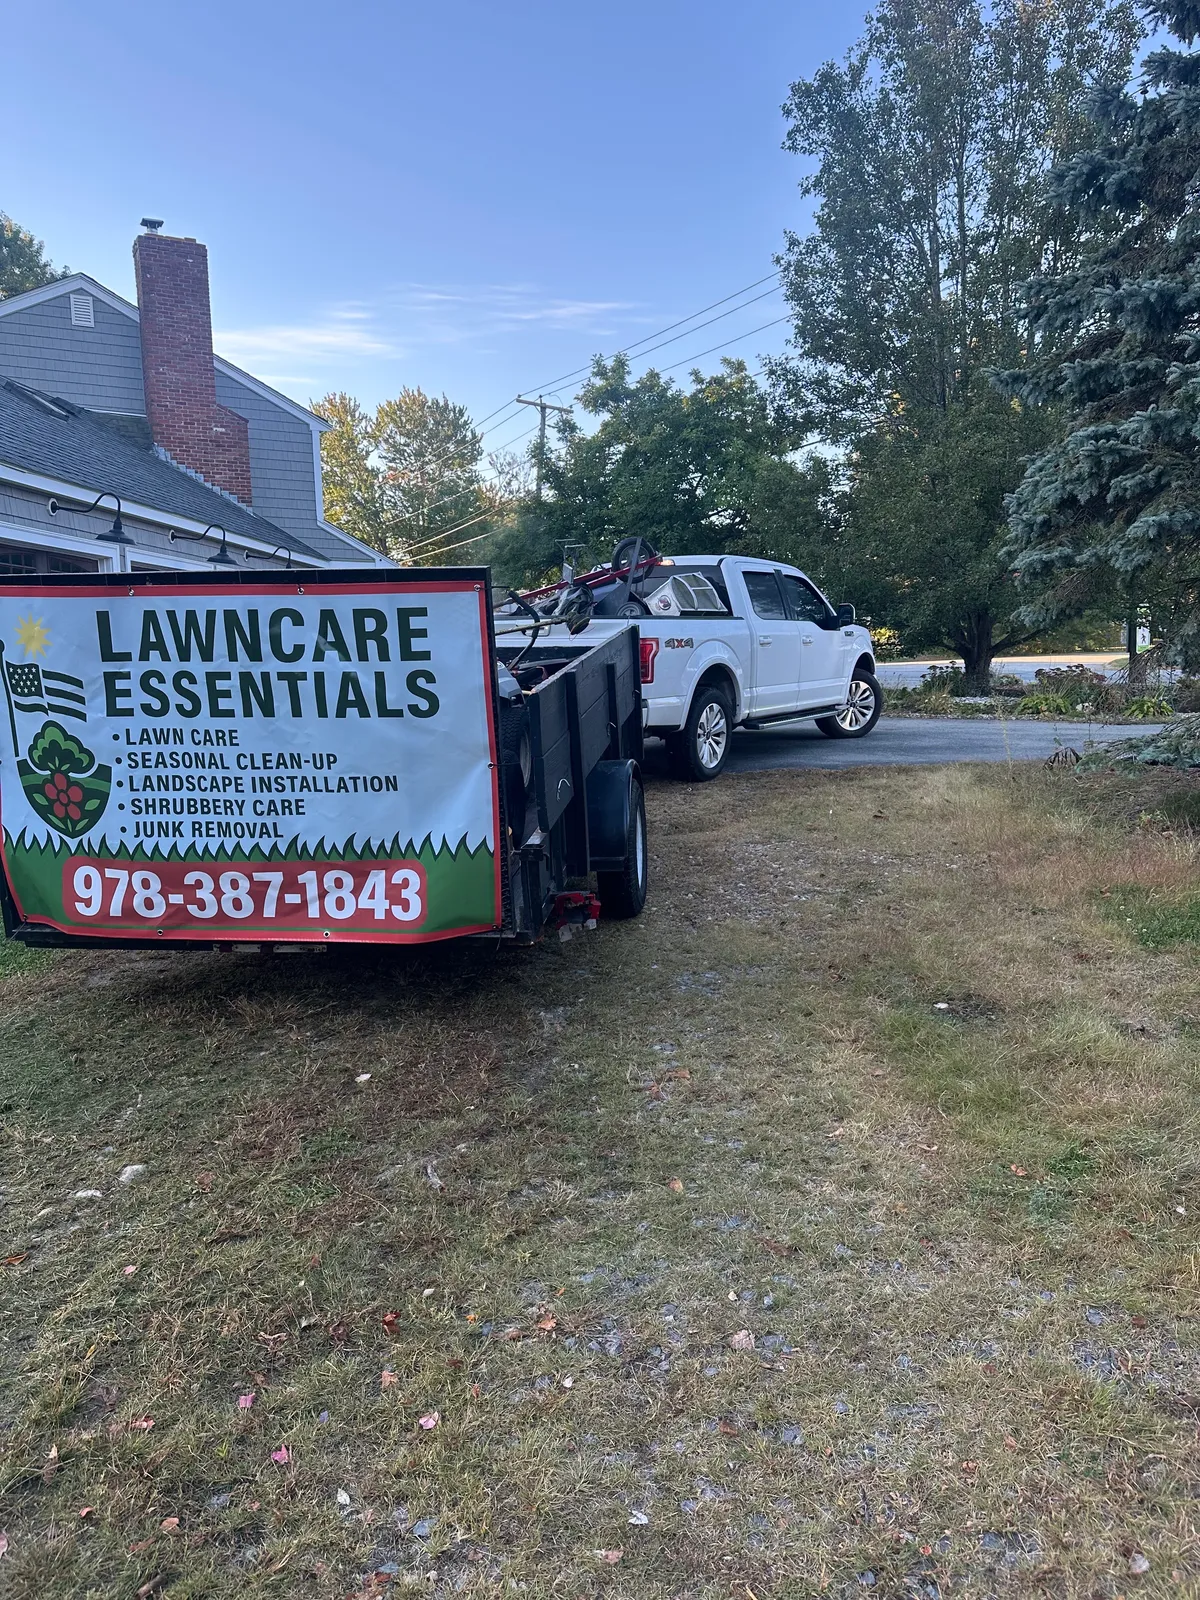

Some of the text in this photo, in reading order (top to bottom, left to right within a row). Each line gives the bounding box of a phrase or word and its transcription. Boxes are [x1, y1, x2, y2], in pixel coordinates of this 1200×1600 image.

[96, 607, 432, 662] LAWNCARE
[103, 669, 440, 718] ESSENTIALS
[125, 728, 239, 747] LAWN CARE
[127, 752, 338, 770] SEASONAL CLEAN-UP
[129, 775, 399, 794] LANDSCAPE INSTALLATION
[131, 798, 306, 816] SHRUBBERY CARE
[134, 821, 284, 839] JUNK REMOVAL
[73, 866, 422, 922] 978-387-1843
